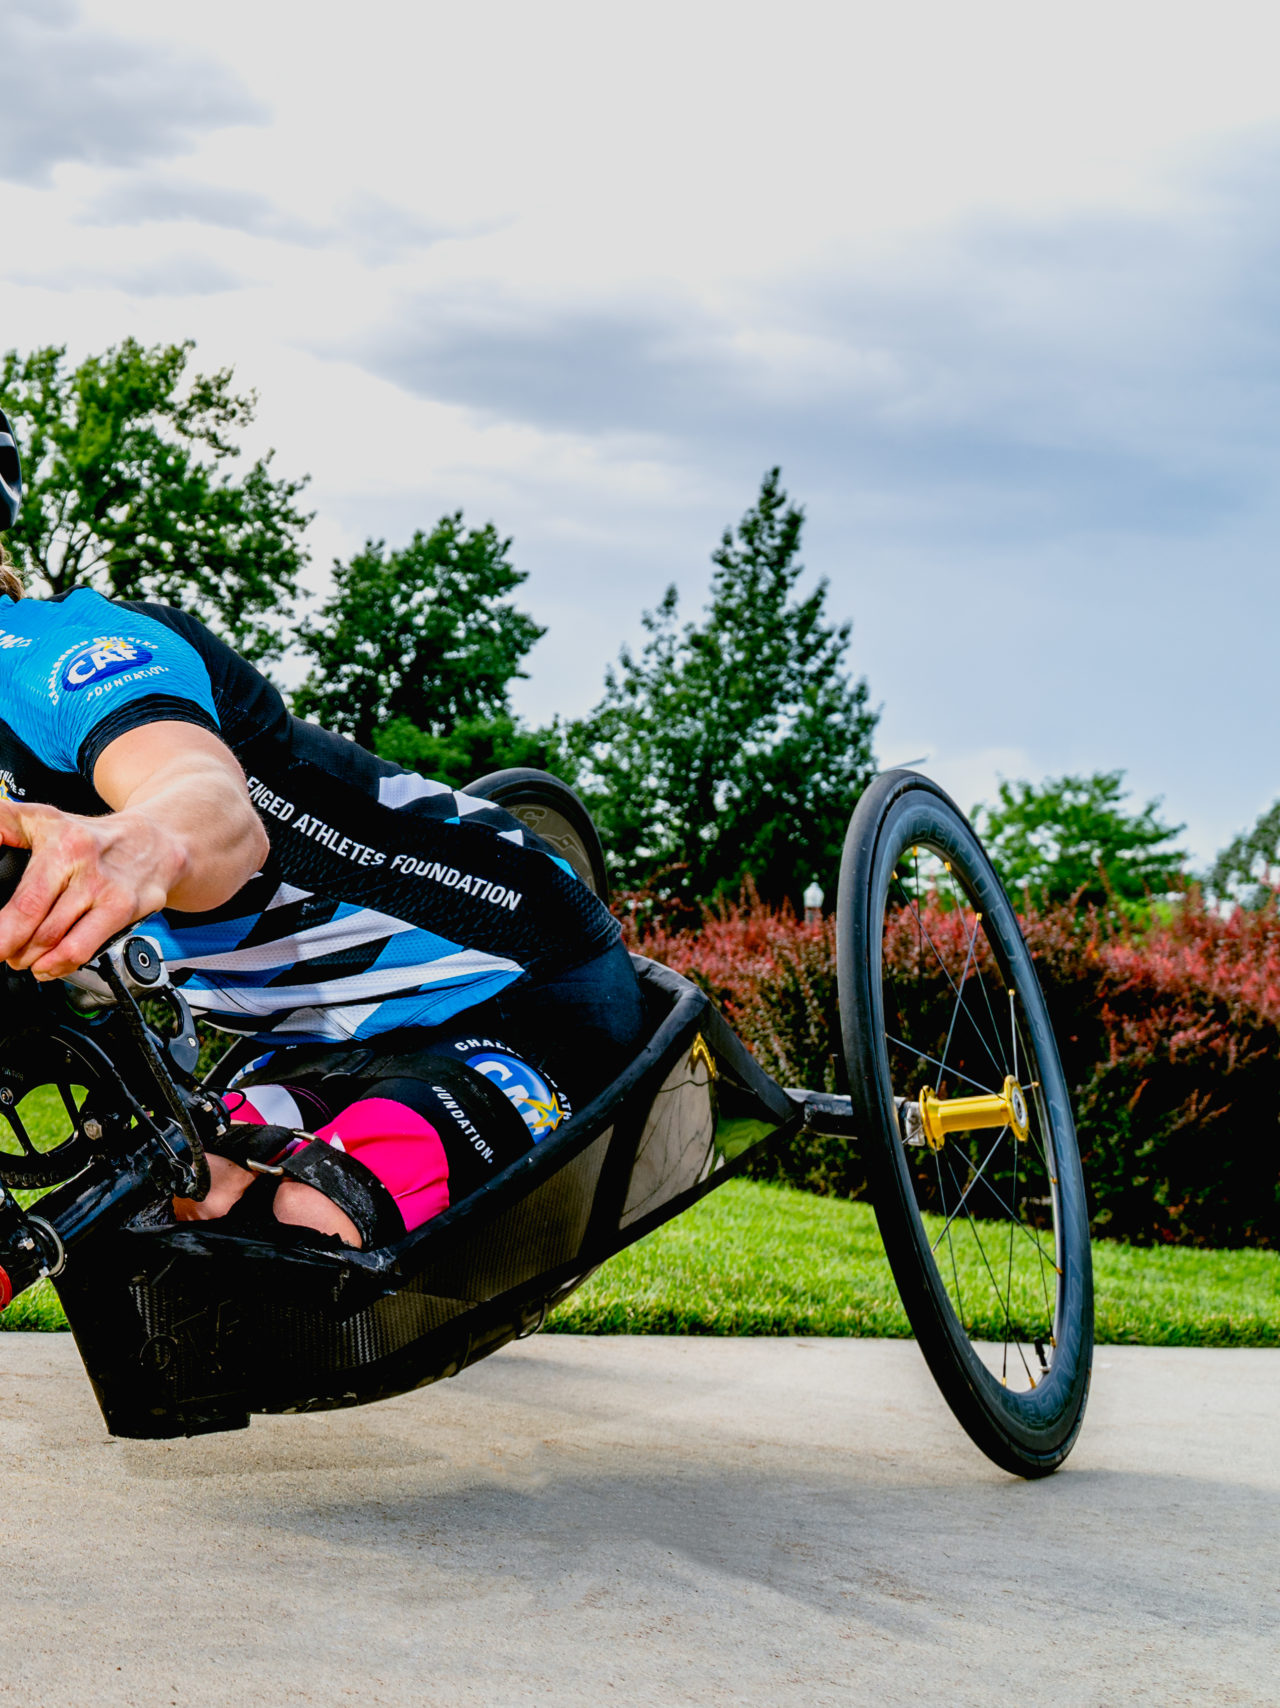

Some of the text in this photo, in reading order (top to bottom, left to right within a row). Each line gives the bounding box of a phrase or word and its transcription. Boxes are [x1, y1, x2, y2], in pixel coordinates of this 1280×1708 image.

[67, 644, 137, 684] CAF
[292, 813, 386, 866] ATHLETES
[390, 854, 522, 911] FOUNDATION
